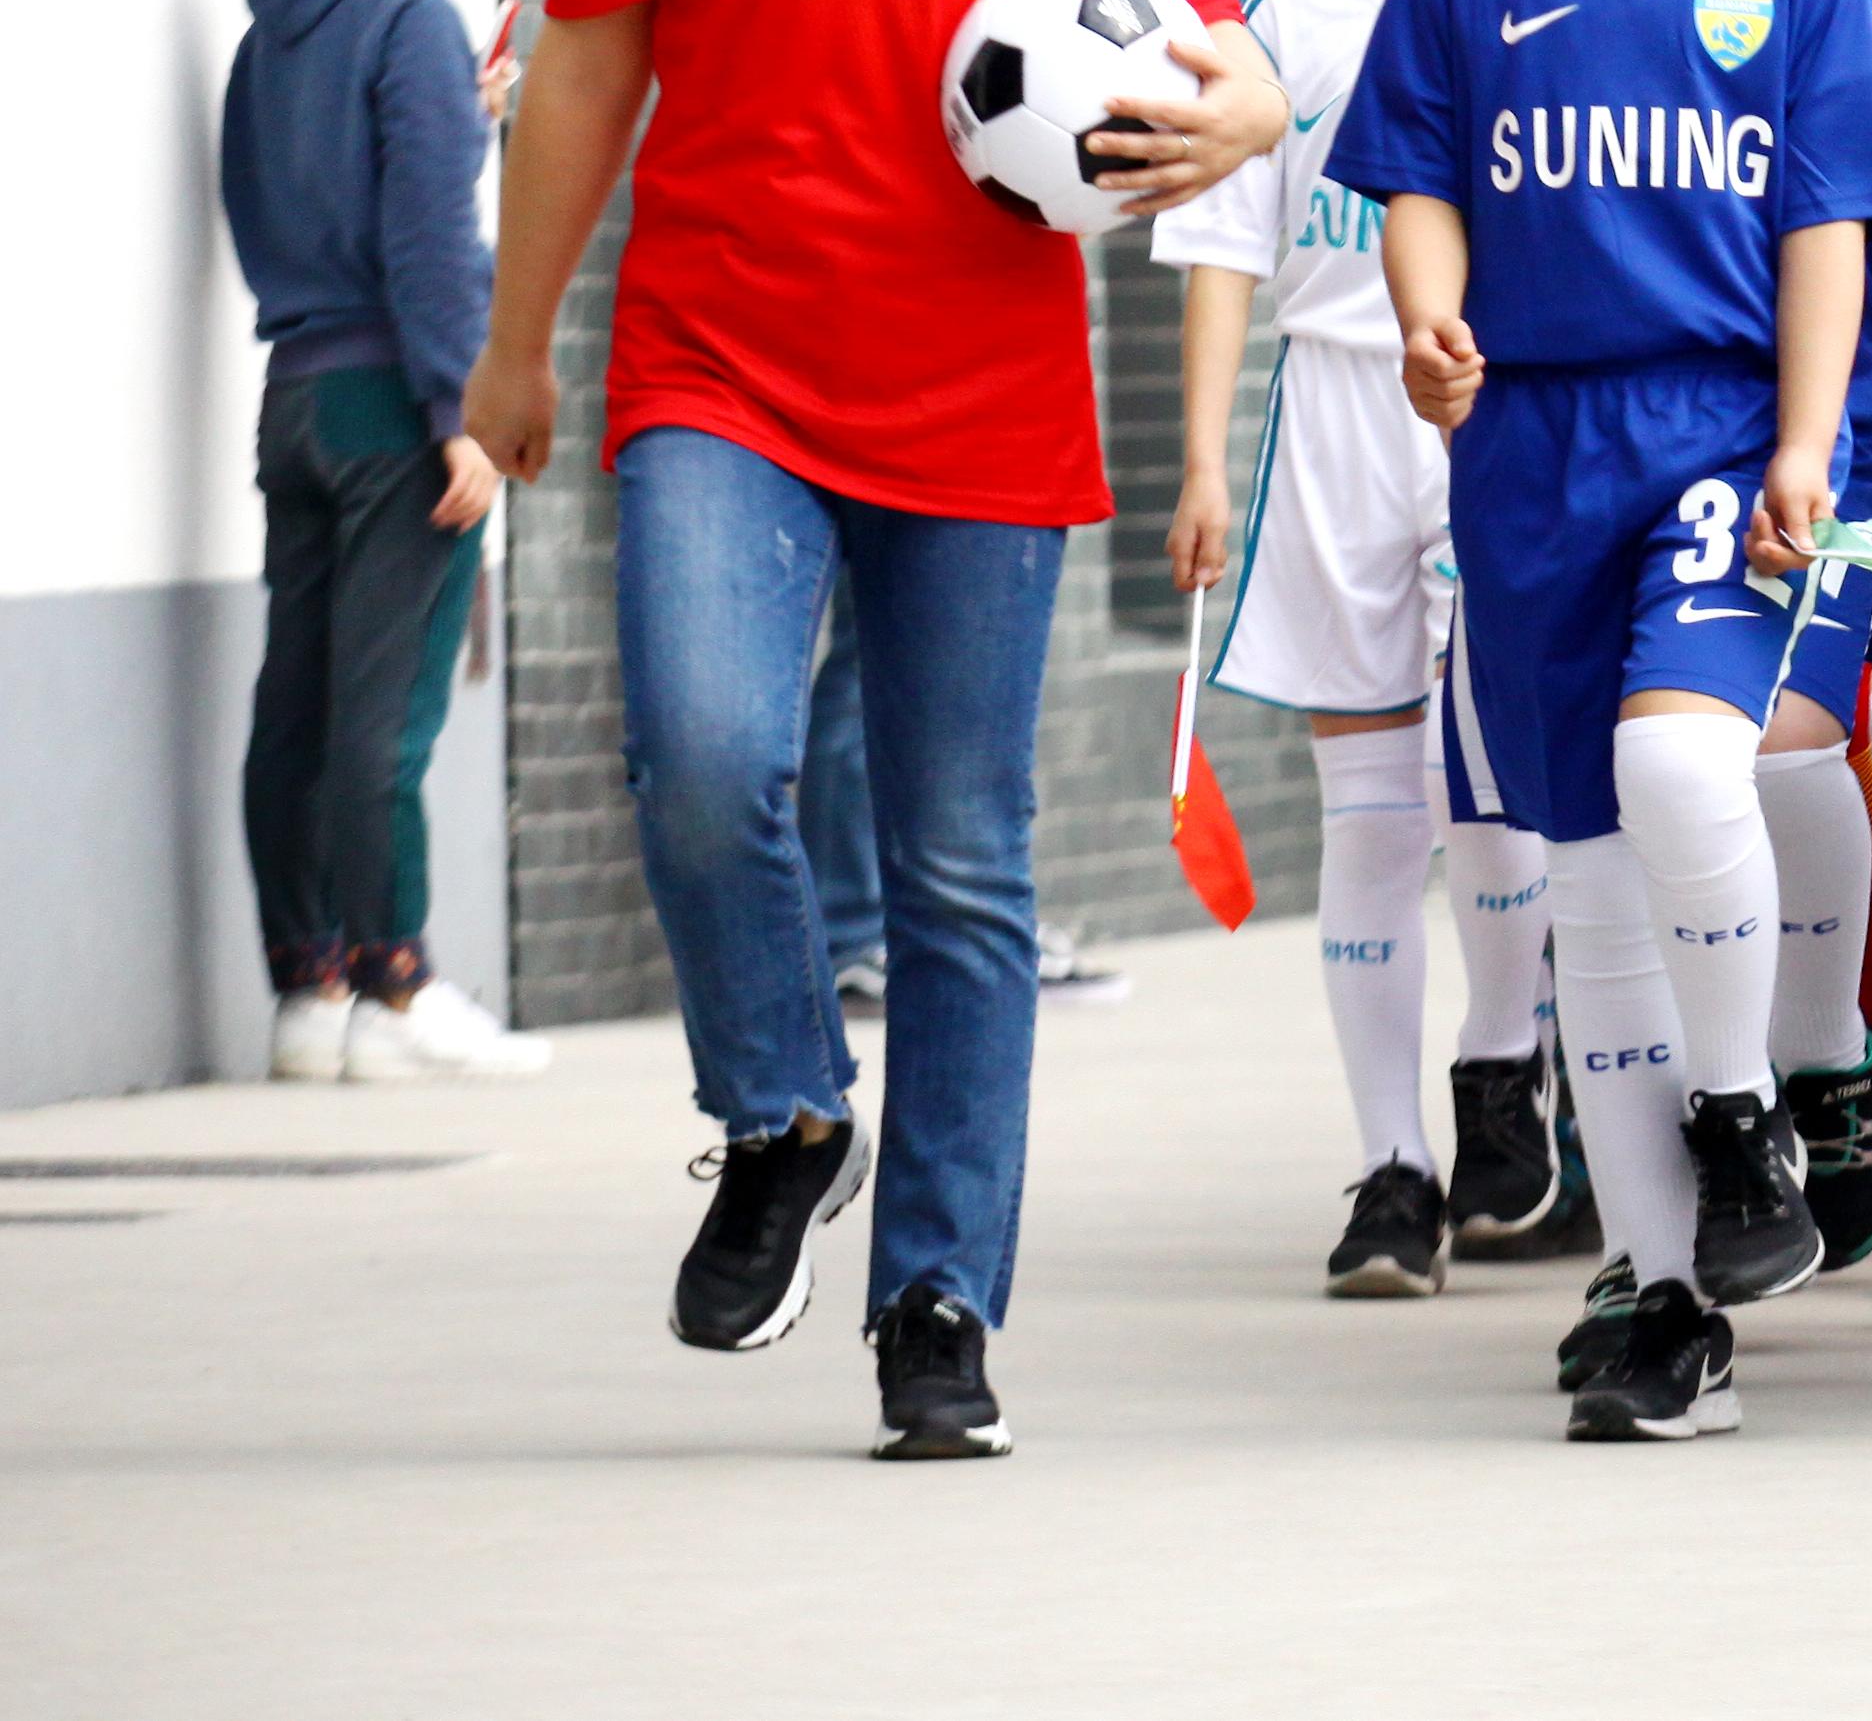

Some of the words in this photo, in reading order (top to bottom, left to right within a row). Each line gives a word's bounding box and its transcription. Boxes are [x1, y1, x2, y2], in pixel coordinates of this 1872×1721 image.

[1490, 105, 1774, 198] SUNING
[1675, 916, 1759, 946] CFC
[1780, 915, 1841, 936] FC
[1585, 1043, 1671, 1073] CFC
